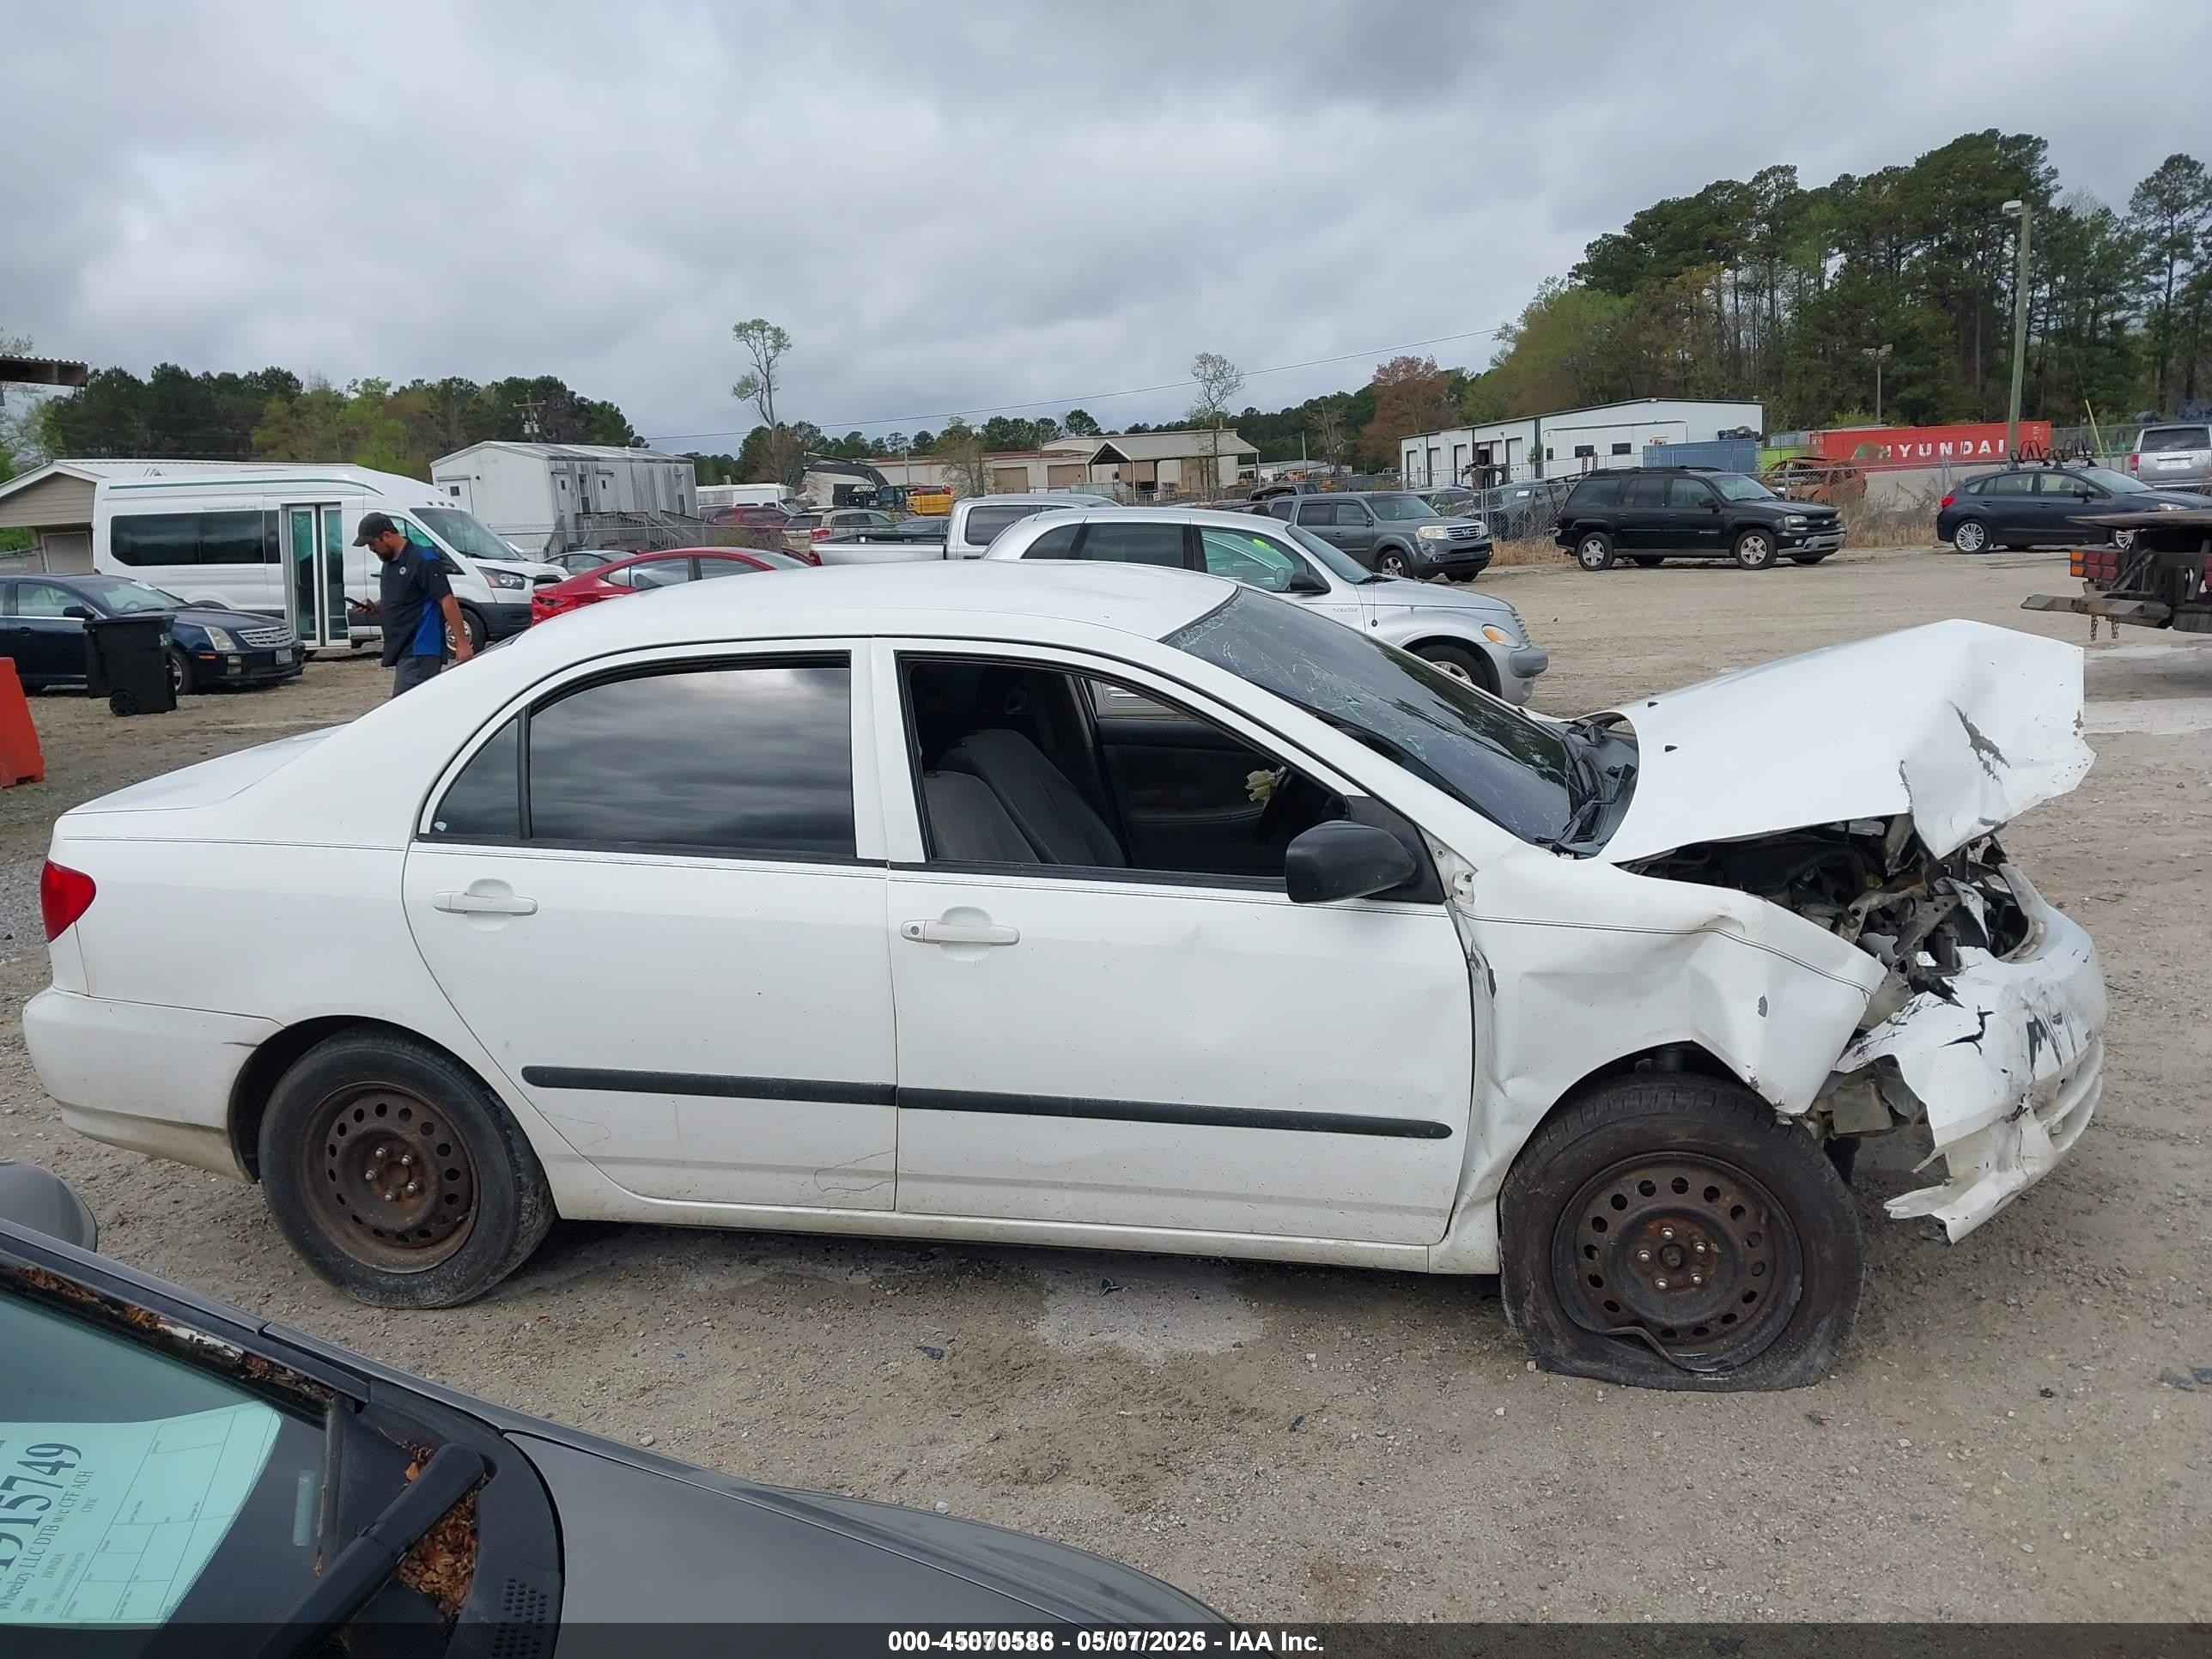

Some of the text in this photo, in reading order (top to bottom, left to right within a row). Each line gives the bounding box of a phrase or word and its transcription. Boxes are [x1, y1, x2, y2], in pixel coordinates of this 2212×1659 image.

[19, 1547, 46, 1568] LLC
[33, 1524, 60, 1545] DTB
[58, 1491, 81, 1509] CFF
[70, 1470, 94, 1491] ACH
[41, 1553, 66, 1578] HONDA
